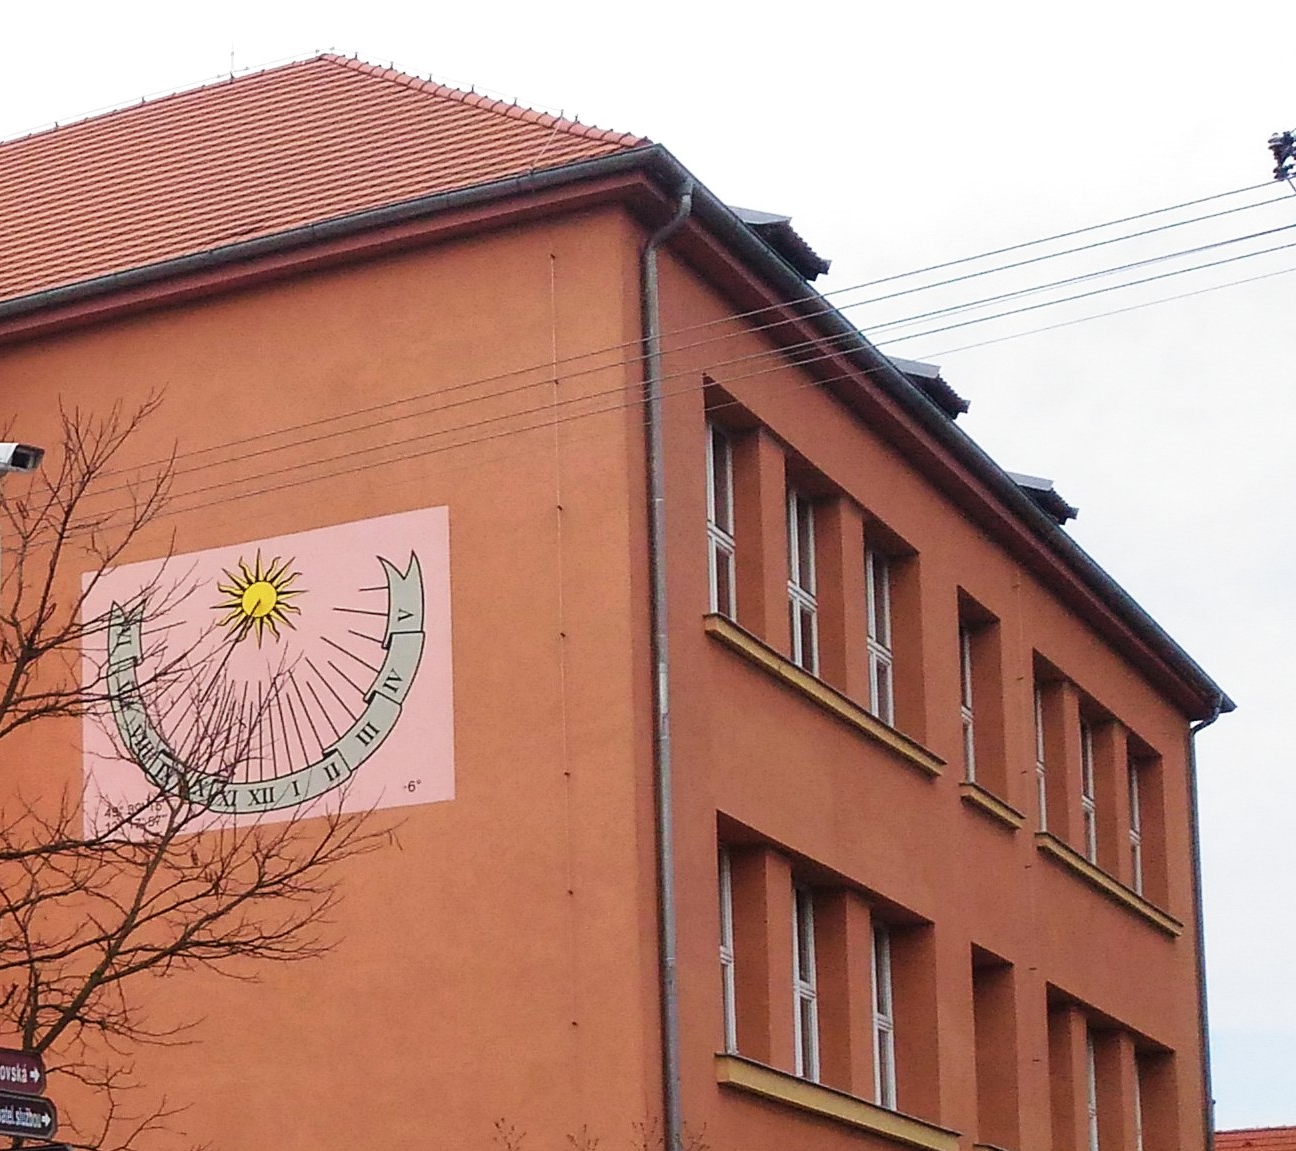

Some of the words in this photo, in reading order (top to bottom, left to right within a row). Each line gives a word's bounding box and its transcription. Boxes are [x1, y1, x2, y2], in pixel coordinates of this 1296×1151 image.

[248, 787, 275, 806] XII
[291, 780, 302, 798] I
[323, 762, 341, 782] II
[355, 720, 381, 748] III
[382, 667, 403, 694] IV
[397, 608, 415, 622] V
